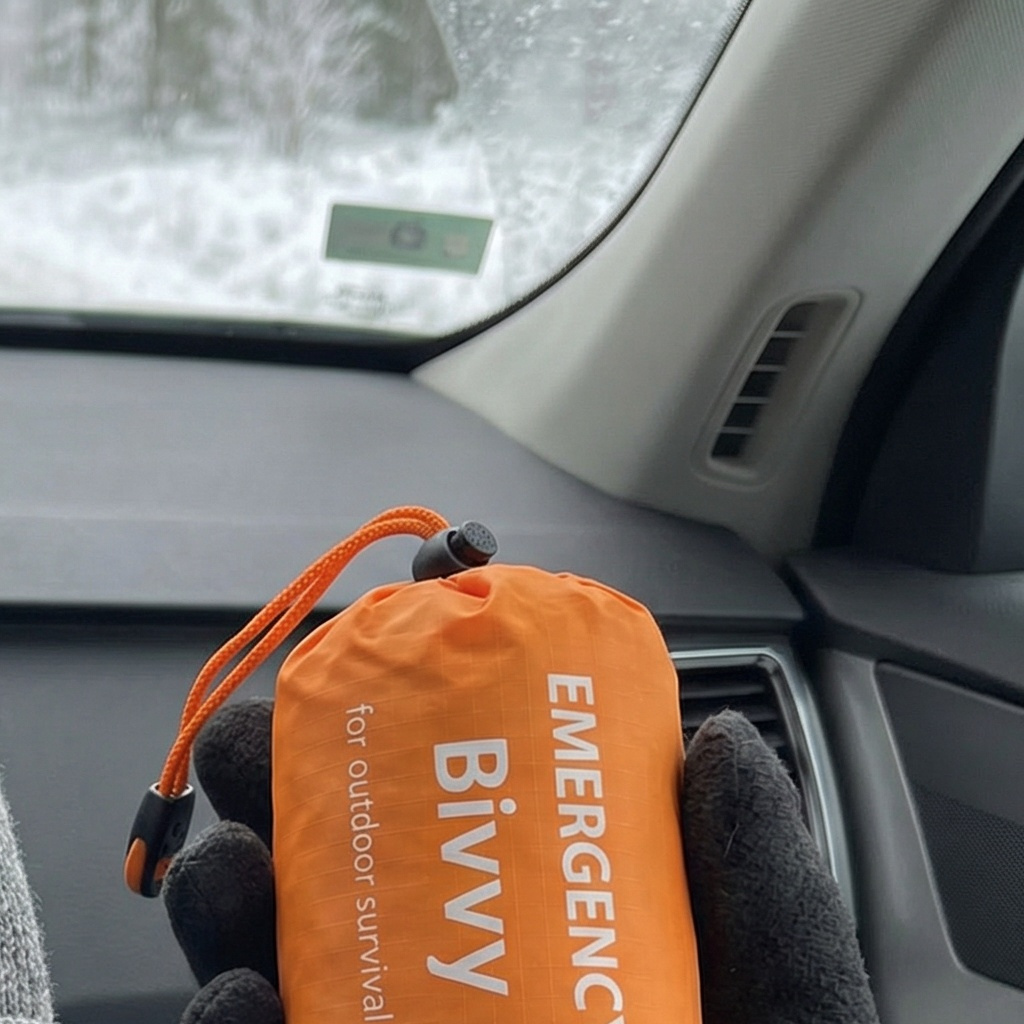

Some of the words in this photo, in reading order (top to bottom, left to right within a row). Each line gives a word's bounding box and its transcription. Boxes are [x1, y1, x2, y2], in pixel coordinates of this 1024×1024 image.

[346, 704, 373, 747] for
[348, 759, 380, 886] outdoor
[426, 738, 517, 996] Bivvy
[357, 897, 394, 1022] survival
